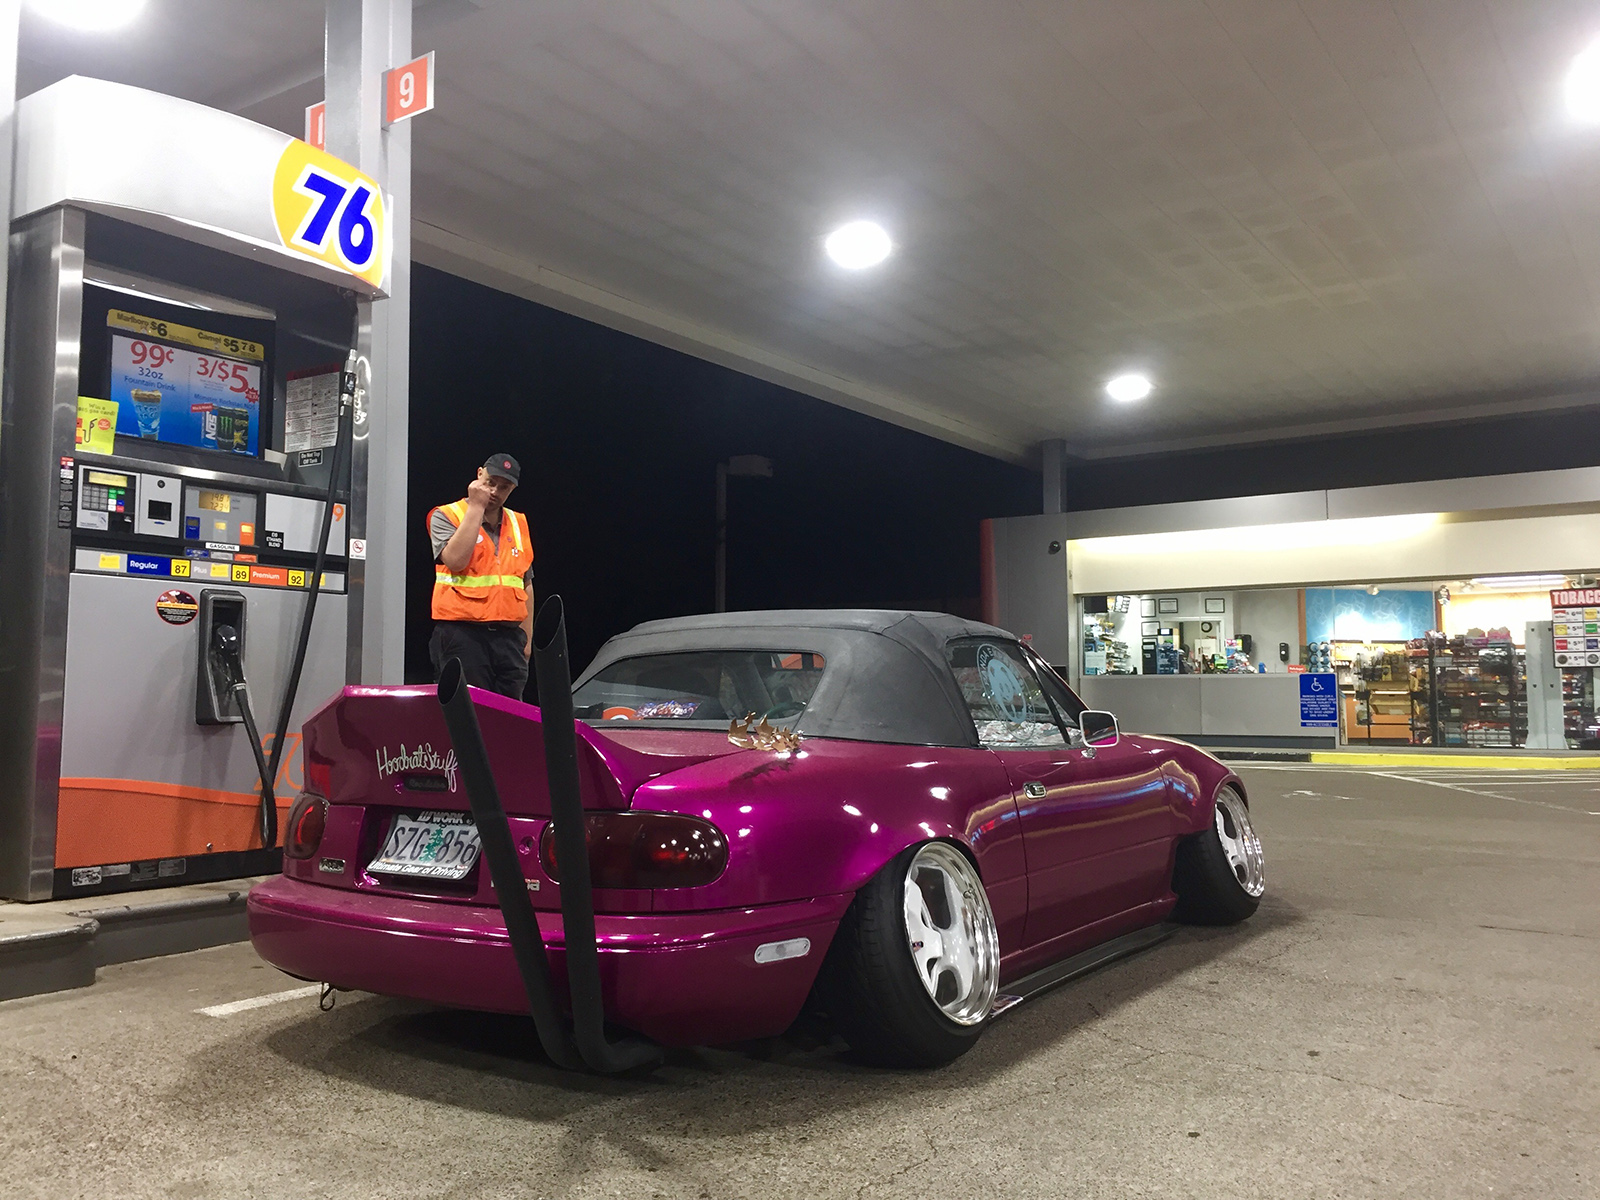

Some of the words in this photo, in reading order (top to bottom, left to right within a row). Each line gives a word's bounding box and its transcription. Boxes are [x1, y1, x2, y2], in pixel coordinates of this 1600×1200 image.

[399, 71, 415, 109] 9
[296, 166, 377, 271] 76
[116, 312, 150, 328] Marlboro
[150, 322, 168, 337] $6
[197, 331, 222, 344] Camel
[124, 375, 156, 388] Fountain
[157, 381, 177, 392] Drink
[333, 504, 344, 522] 9
[129, 560, 159, 570] Regular
[174, 564, 187, 574] 87
[193, 566, 208, 574] Plus
[235, 570, 247, 580] 89
[252, 570, 280, 580] Premium
[290, 575, 302, 585] 92
[432, 811, 465, 824] WORK
[384, 826, 431, 861] SZG
[434, 829, 480, 864] 856
[368, 860, 402, 872] Ultimate
[401, 864, 421, 873] Gear
[421, 866, 432, 874] of
[431, 866, 464, 878] Driving
